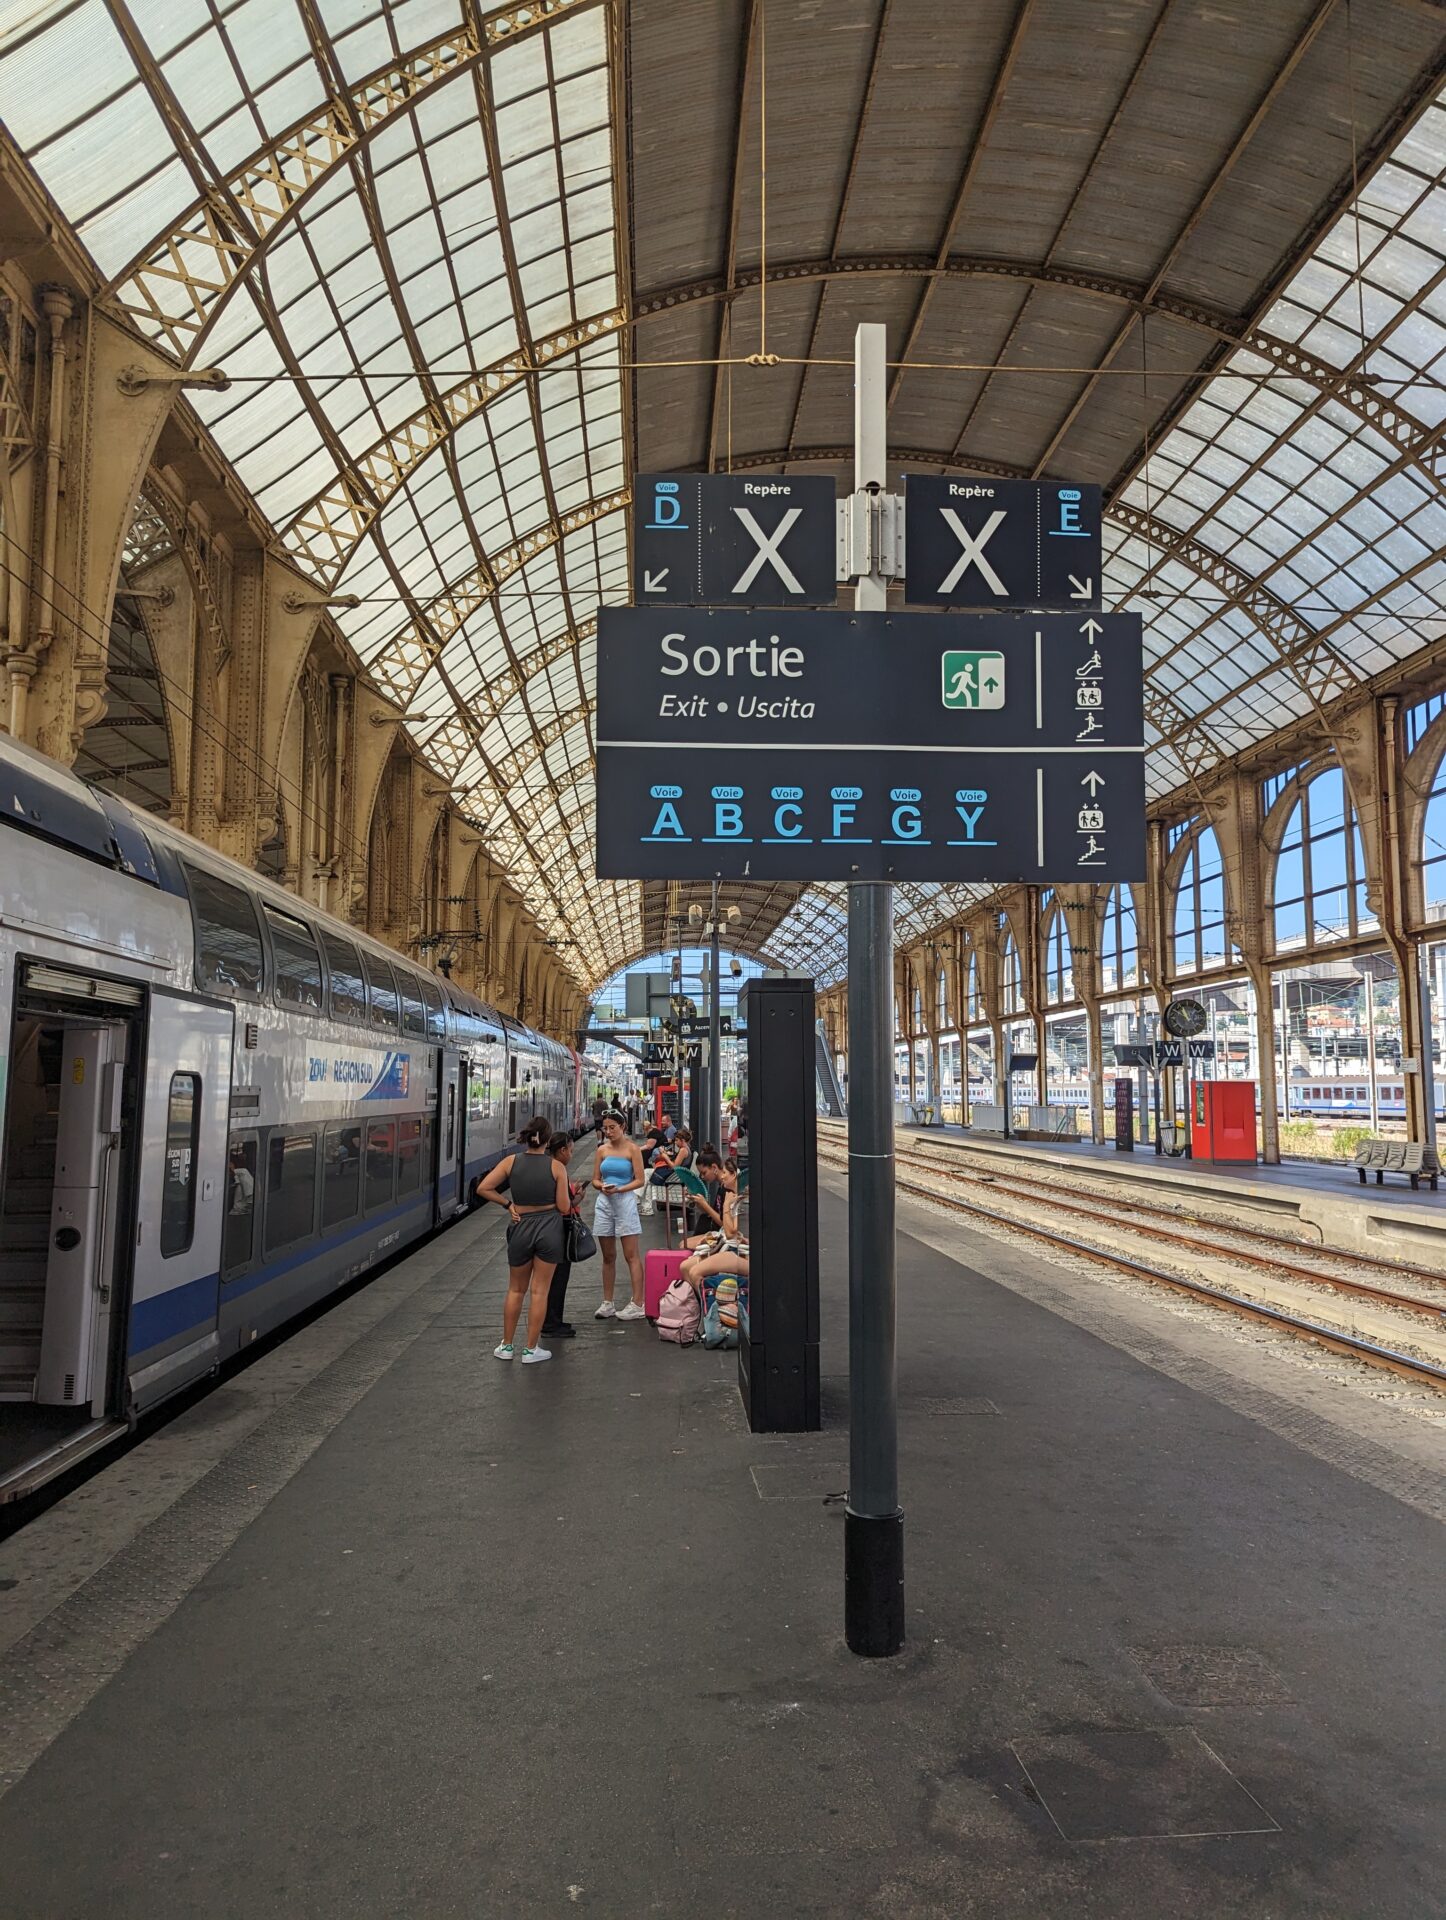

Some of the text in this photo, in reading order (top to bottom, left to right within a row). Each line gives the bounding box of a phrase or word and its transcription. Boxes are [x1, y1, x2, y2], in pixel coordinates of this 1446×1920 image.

[744, 483, 791, 498] Repère
[949, 484, 995, 499] Repère
[1061, 491, 1078, 499] Voie
[655, 496, 680, 524] D
[1061, 504, 1080, 531] E
[730, 507, 805, 594] X
[937, 509, 1009, 596] X
[660, 633, 805, 678] Sortie
[659, 694, 816, 720] Exit Uscita
[654, 787, 983, 801] Voie Voie Voie Voie Voie Voie
[652, 803, 985, 839] A B C F G Y
[657, 1046, 673, 1059] W
[1164, 1044, 1180, 1057] W
[1190, 1044, 1206, 1057] W
[334, 1056, 360, 1084] RÉGION
[360, 1062, 373, 1084] SUD
